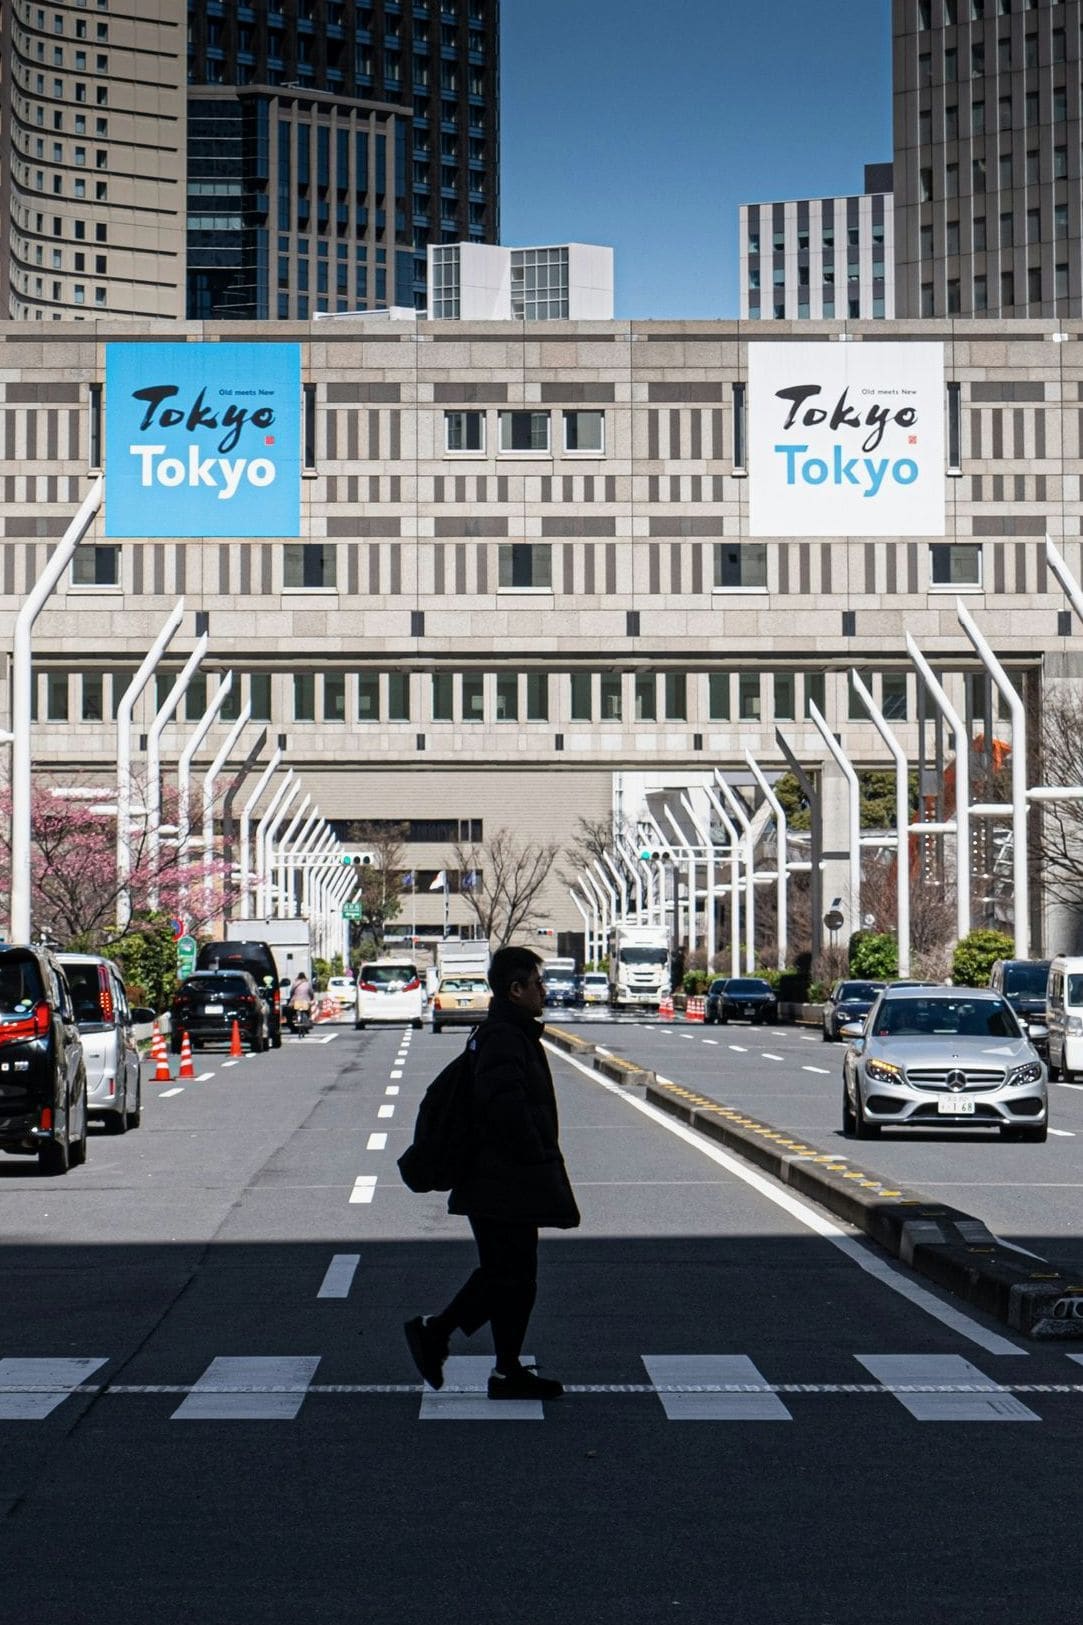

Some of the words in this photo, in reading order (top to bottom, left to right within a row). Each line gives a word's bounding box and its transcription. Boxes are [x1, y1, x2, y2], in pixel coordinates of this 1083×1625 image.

[132, 386, 275, 453] Tokyo
[775, 385, 918, 453] Tokyo
[130, 445, 276, 499] Tokyo
[774, 445, 919, 497] Tokyo
